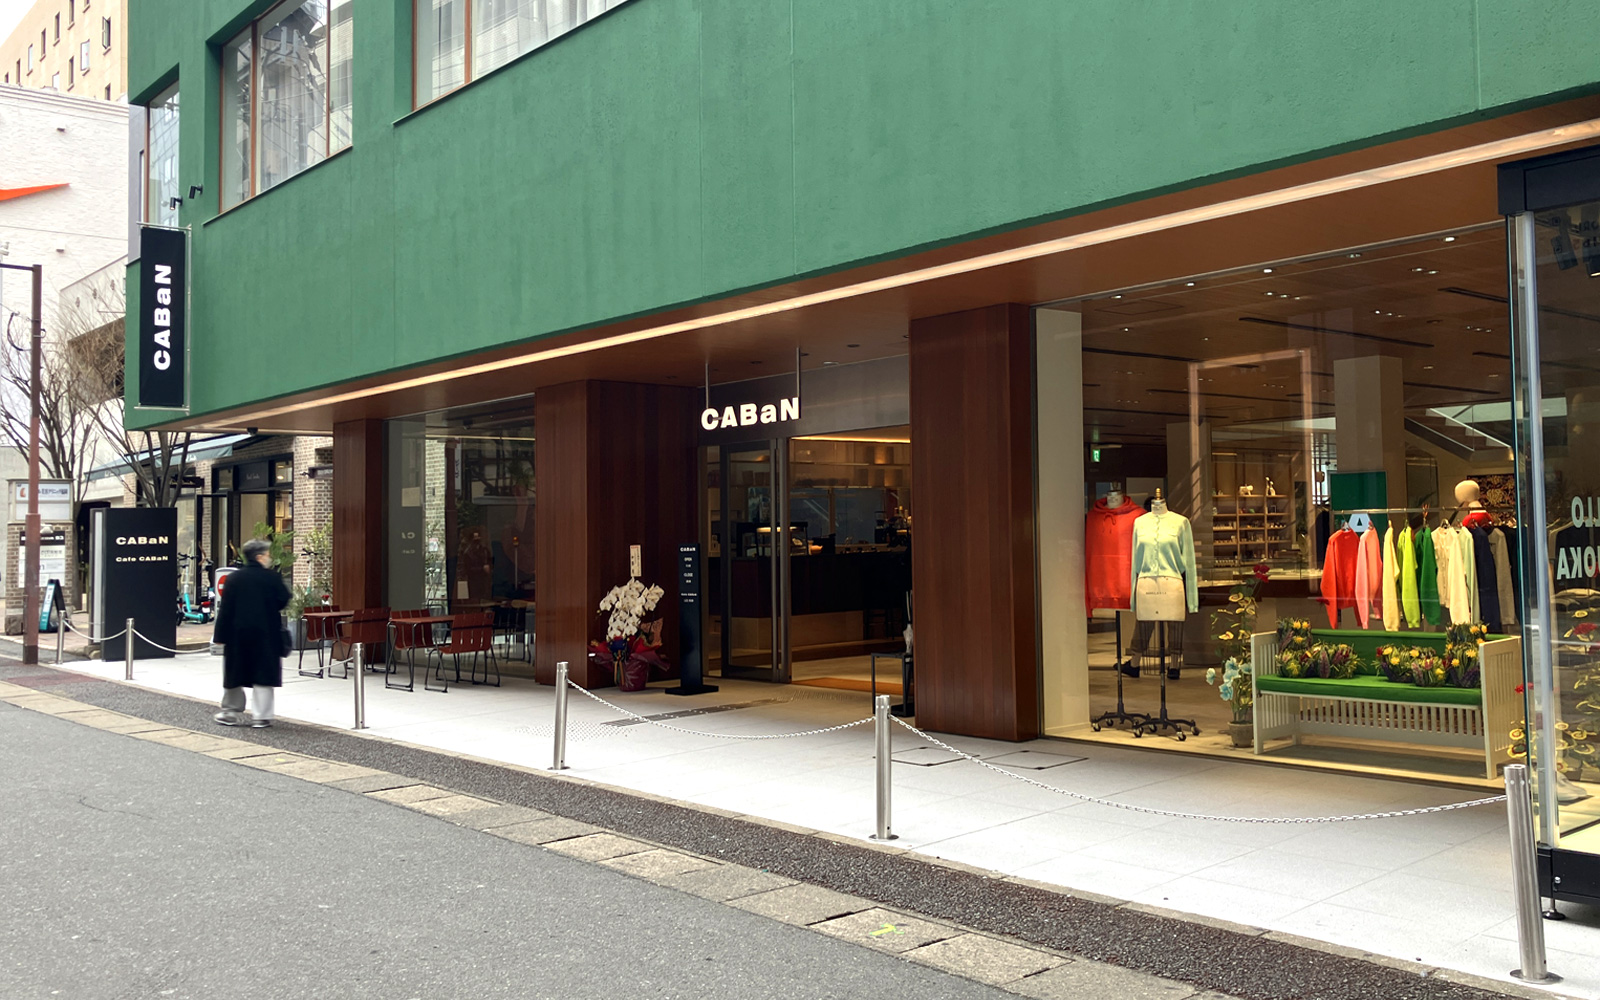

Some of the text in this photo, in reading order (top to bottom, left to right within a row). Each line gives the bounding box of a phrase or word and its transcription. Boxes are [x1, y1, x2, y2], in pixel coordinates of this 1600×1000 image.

[153, 264, 171, 370] CABaN
[701, 397, 799, 430] CABaN
[115, 536, 169, 545] CABaN
